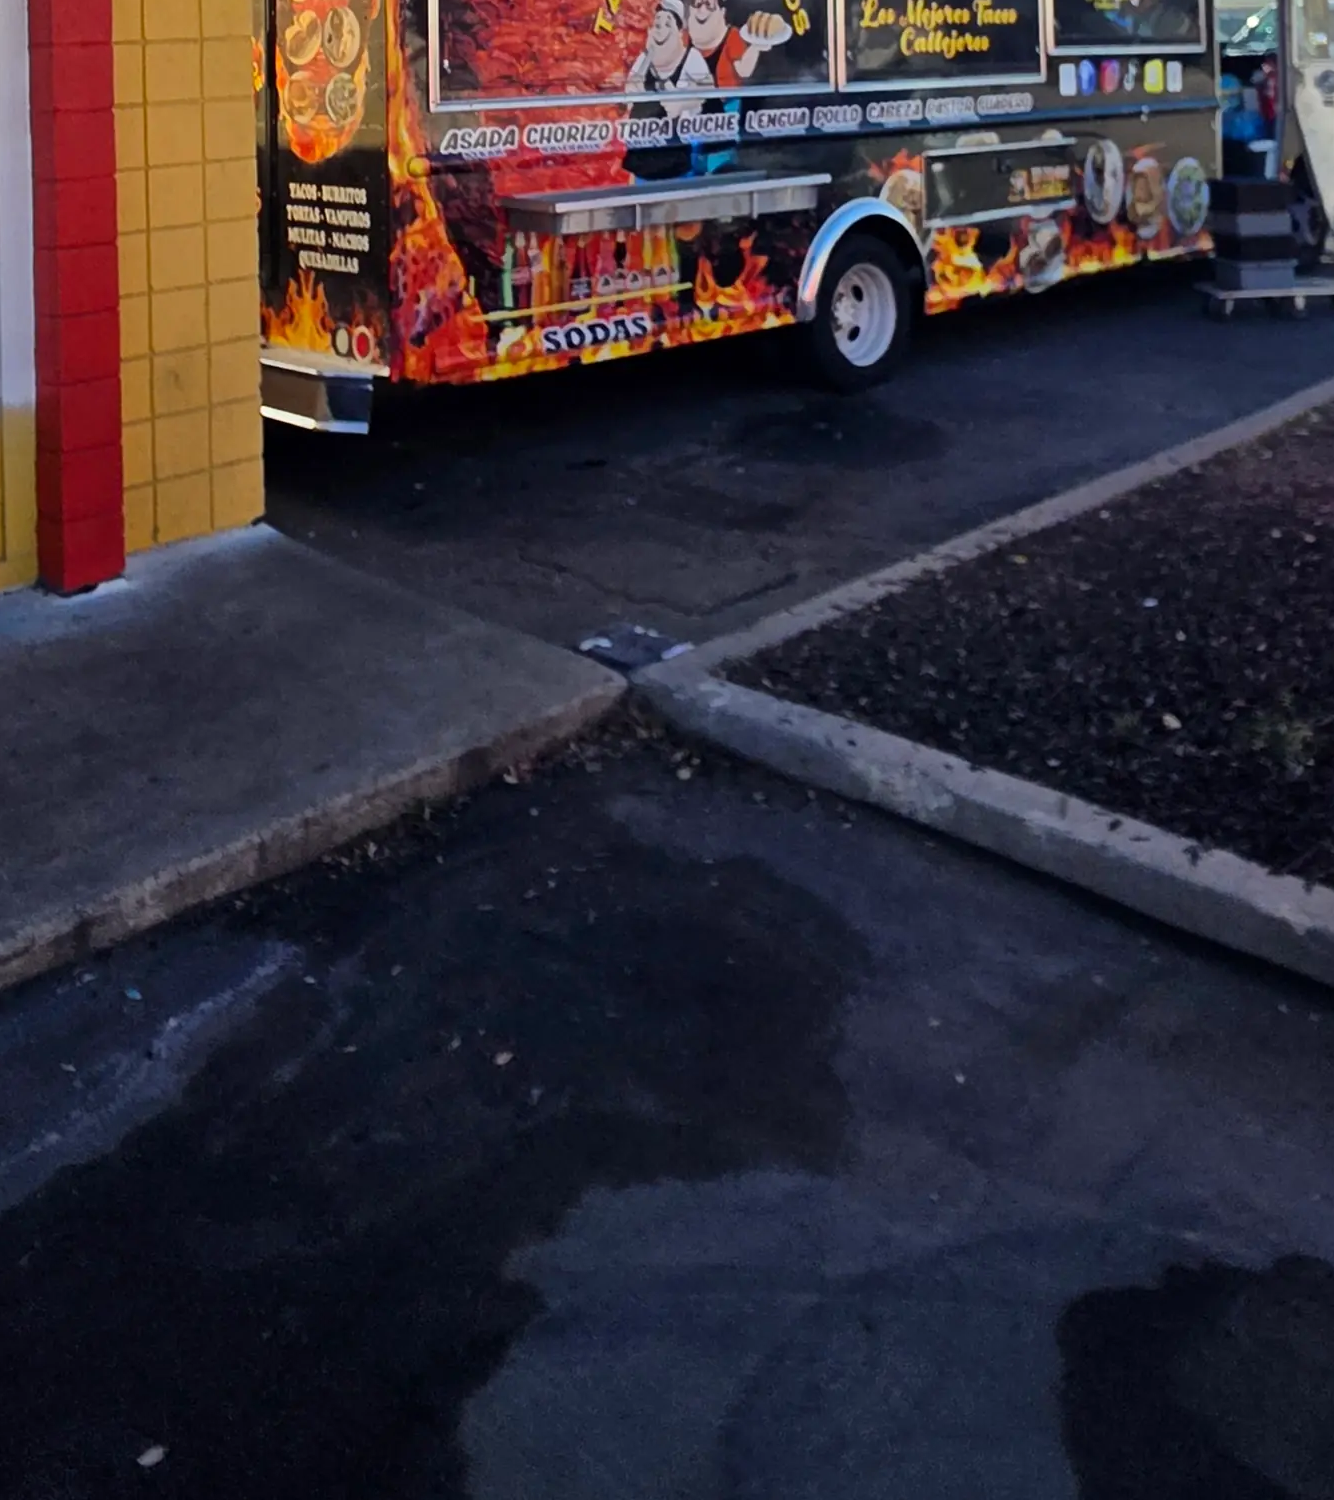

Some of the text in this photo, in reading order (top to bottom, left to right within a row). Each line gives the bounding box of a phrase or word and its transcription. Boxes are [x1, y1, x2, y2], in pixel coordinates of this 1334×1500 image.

[899, 26, 990, 60] Callejeros
[442, 127, 517, 152] ASADA
[526, 122, 611, 146] CHORIZO
[618, 119, 670, 140] TRIPA
[679, 114, 736, 134] BUCHE
[747, 108, 807, 130] LENGUA
[816, 105, 860, 125] POLLO
[868, 100, 922, 120] CABEZA
[289, 182, 367, 205] TACOS BURRITOS
[286, 204, 371, 228] TORTAS VAMPIROS
[287, 226, 369, 252] MULITAS NACHOS
[298, 250, 359, 274] QUESADILLAS
[543, 315, 649, 354] SODAS
